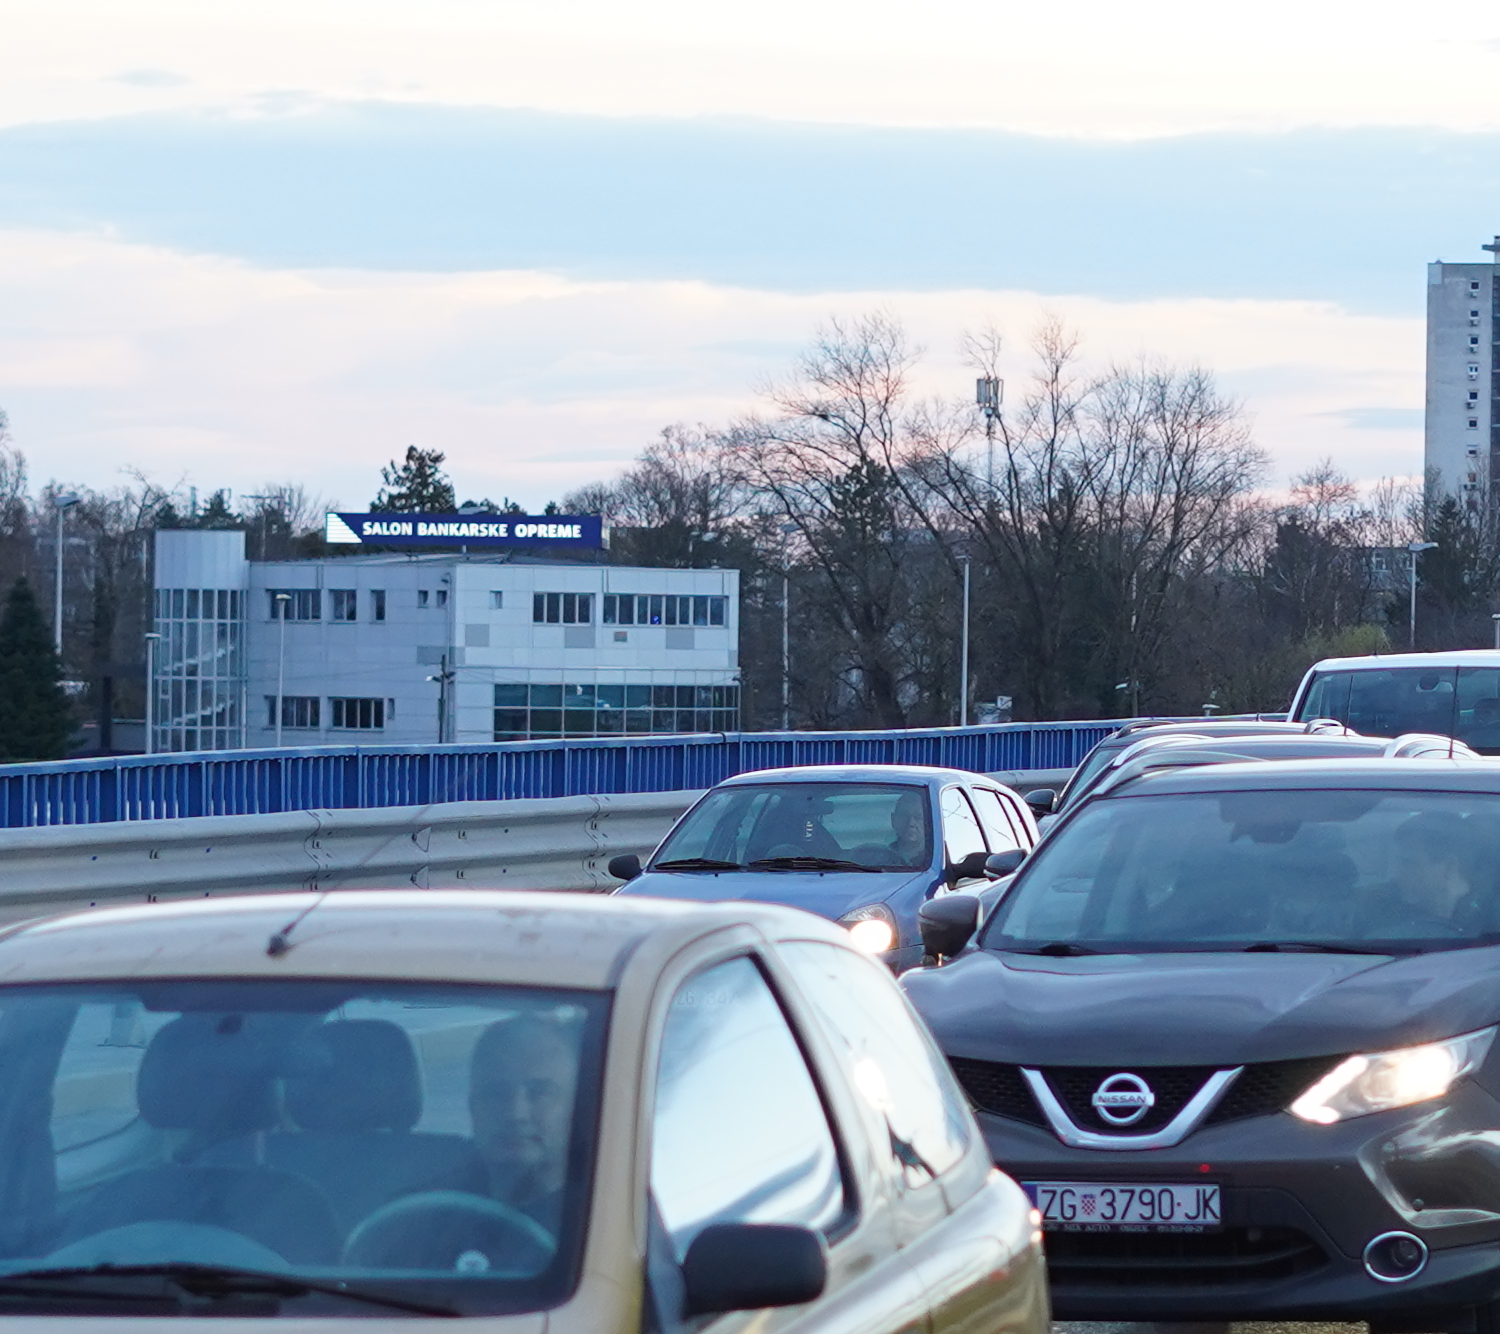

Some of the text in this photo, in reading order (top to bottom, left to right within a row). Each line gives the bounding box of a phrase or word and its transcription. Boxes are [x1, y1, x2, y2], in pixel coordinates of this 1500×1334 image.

[362, 521, 582, 539] SALON BANKARSKE OPREME
[1097, 1095, 1147, 1103] NISSAN
[1041, 1188, 1077, 1221] ZG
